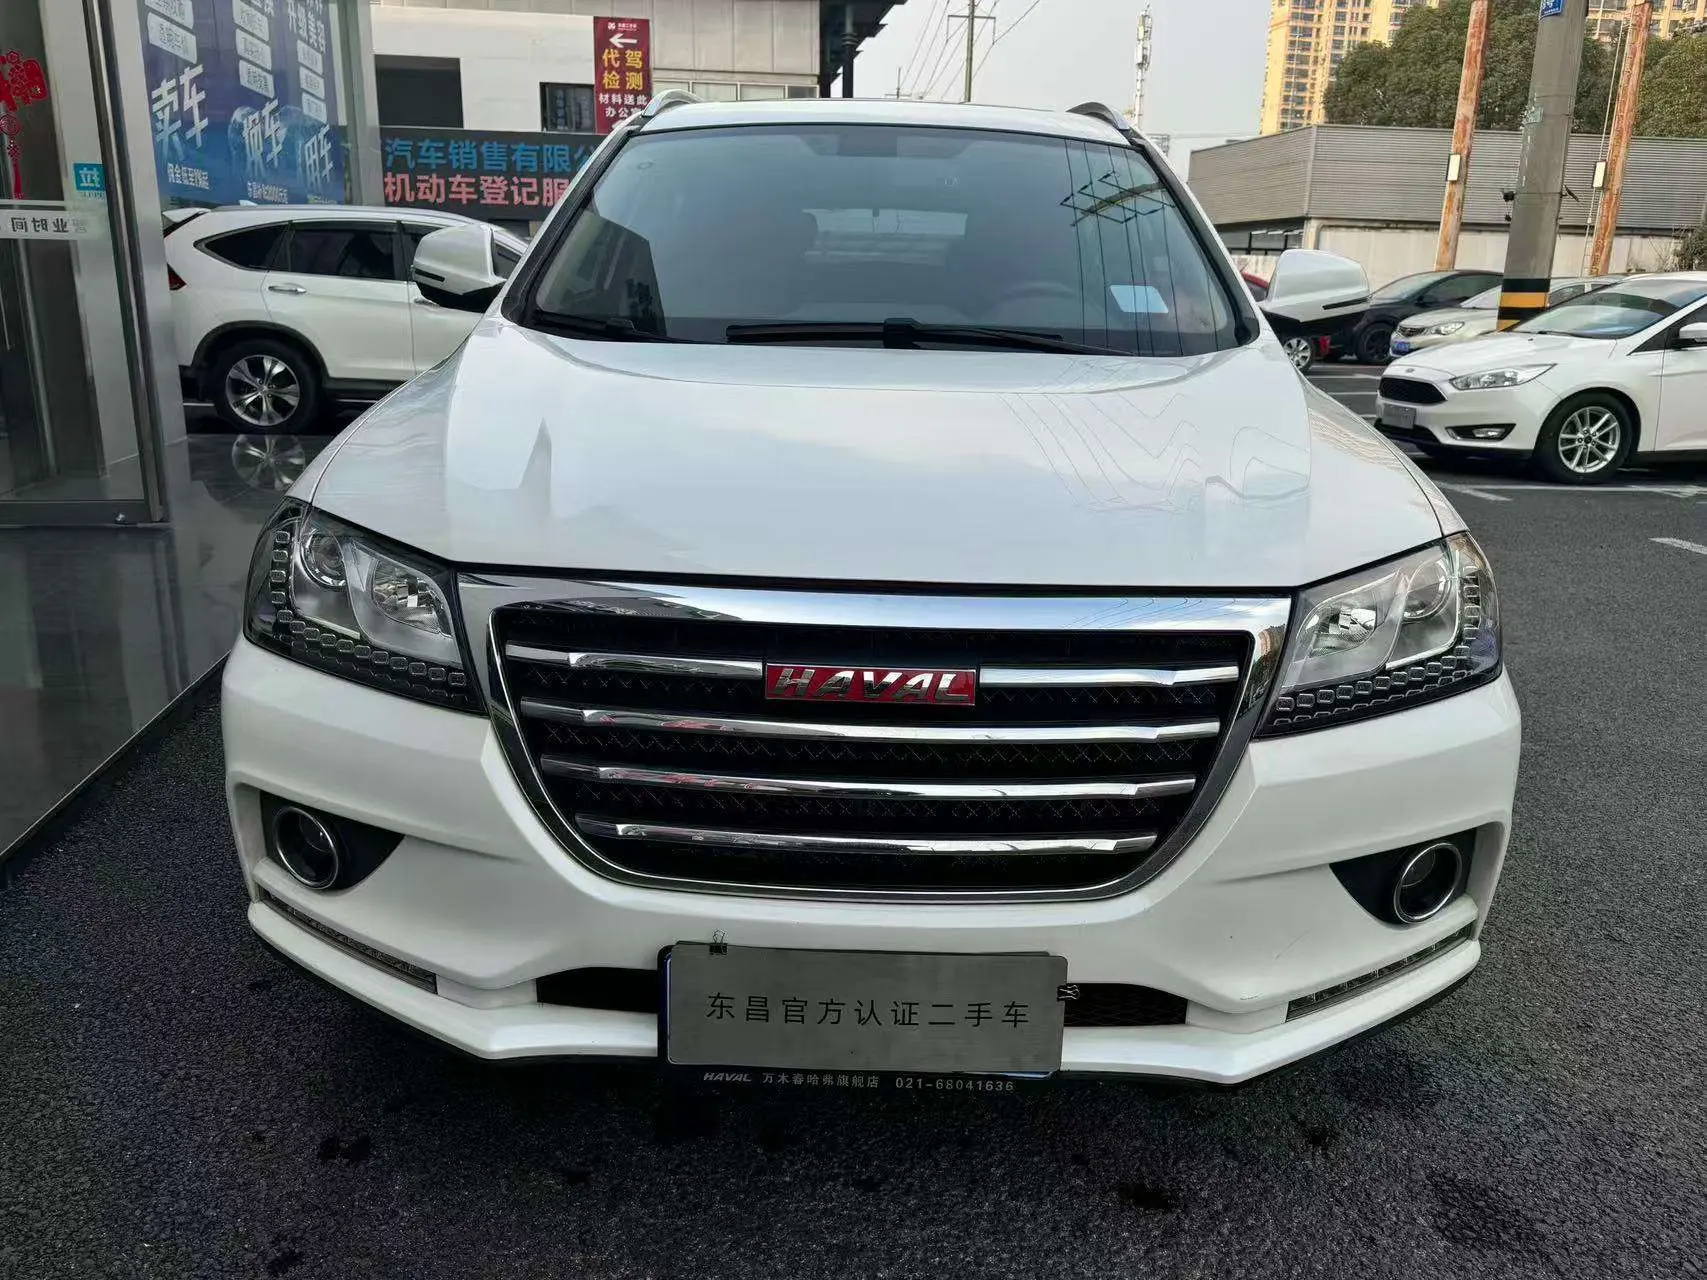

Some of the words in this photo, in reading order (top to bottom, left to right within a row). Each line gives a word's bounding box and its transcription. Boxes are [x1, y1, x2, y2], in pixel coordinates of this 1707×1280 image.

[602, 48, 642, 69] 代驾
[603, 70, 643, 91] 检测
[599, 92, 648, 105] 材料送此
[774, 668, 969, 701] HAVAL
[706, 992, 1030, 1028] 东昌官方认证二手车
[703, 1072, 753, 1082] HAVAL
[895, 1077, 1015, 1091] 021-68041636
